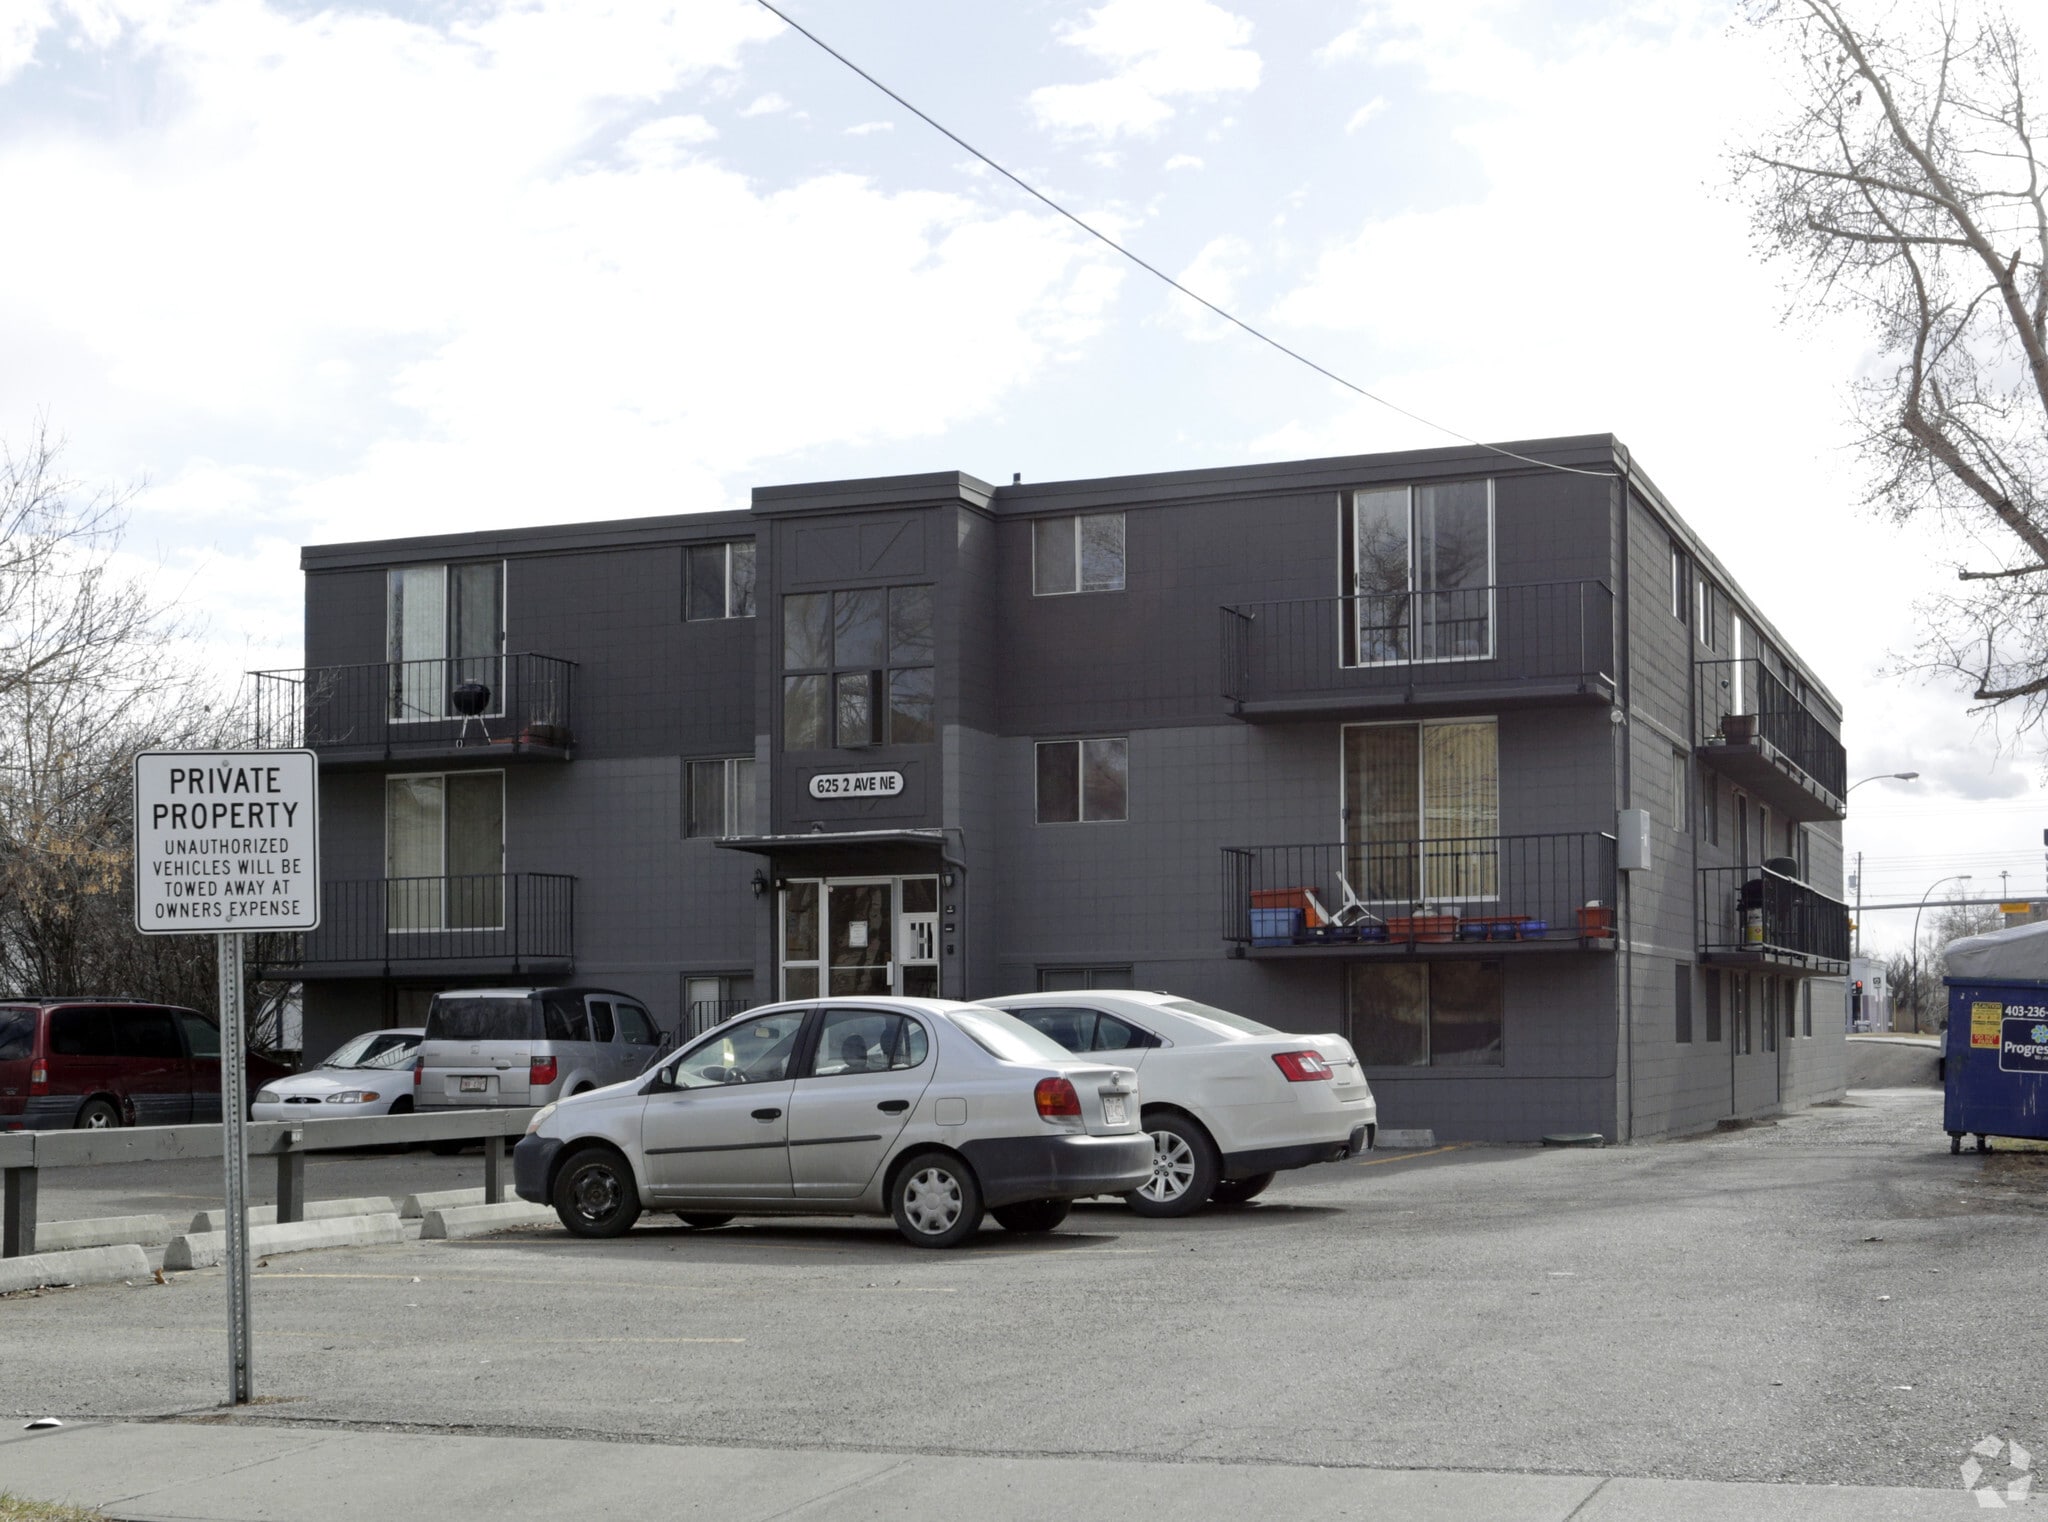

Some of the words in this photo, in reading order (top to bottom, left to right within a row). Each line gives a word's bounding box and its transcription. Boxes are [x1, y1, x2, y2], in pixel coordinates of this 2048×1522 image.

[171, 768, 281, 794] PRIVATE
[817, 779, 838, 793] 625
[843, 778, 850, 792] 2
[854, 777, 876, 791] AVE
[880, 776, 895, 790] NE
[153, 802, 298, 829] PROPERTY
[165, 839, 288, 854] UNAUTHORIZED
[154, 860, 230, 876] VEHICLES
[238, 860, 274, 875] WILL
[282, 859, 301, 874] BE
[165, 882, 217, 897] TOWED
[225, 881, 265, 895] AWAY
[272, 880, 290, 894] AT
[155, 902, 221, 918] OWNERS
[230, 900, 300, 916] EXPENSE
